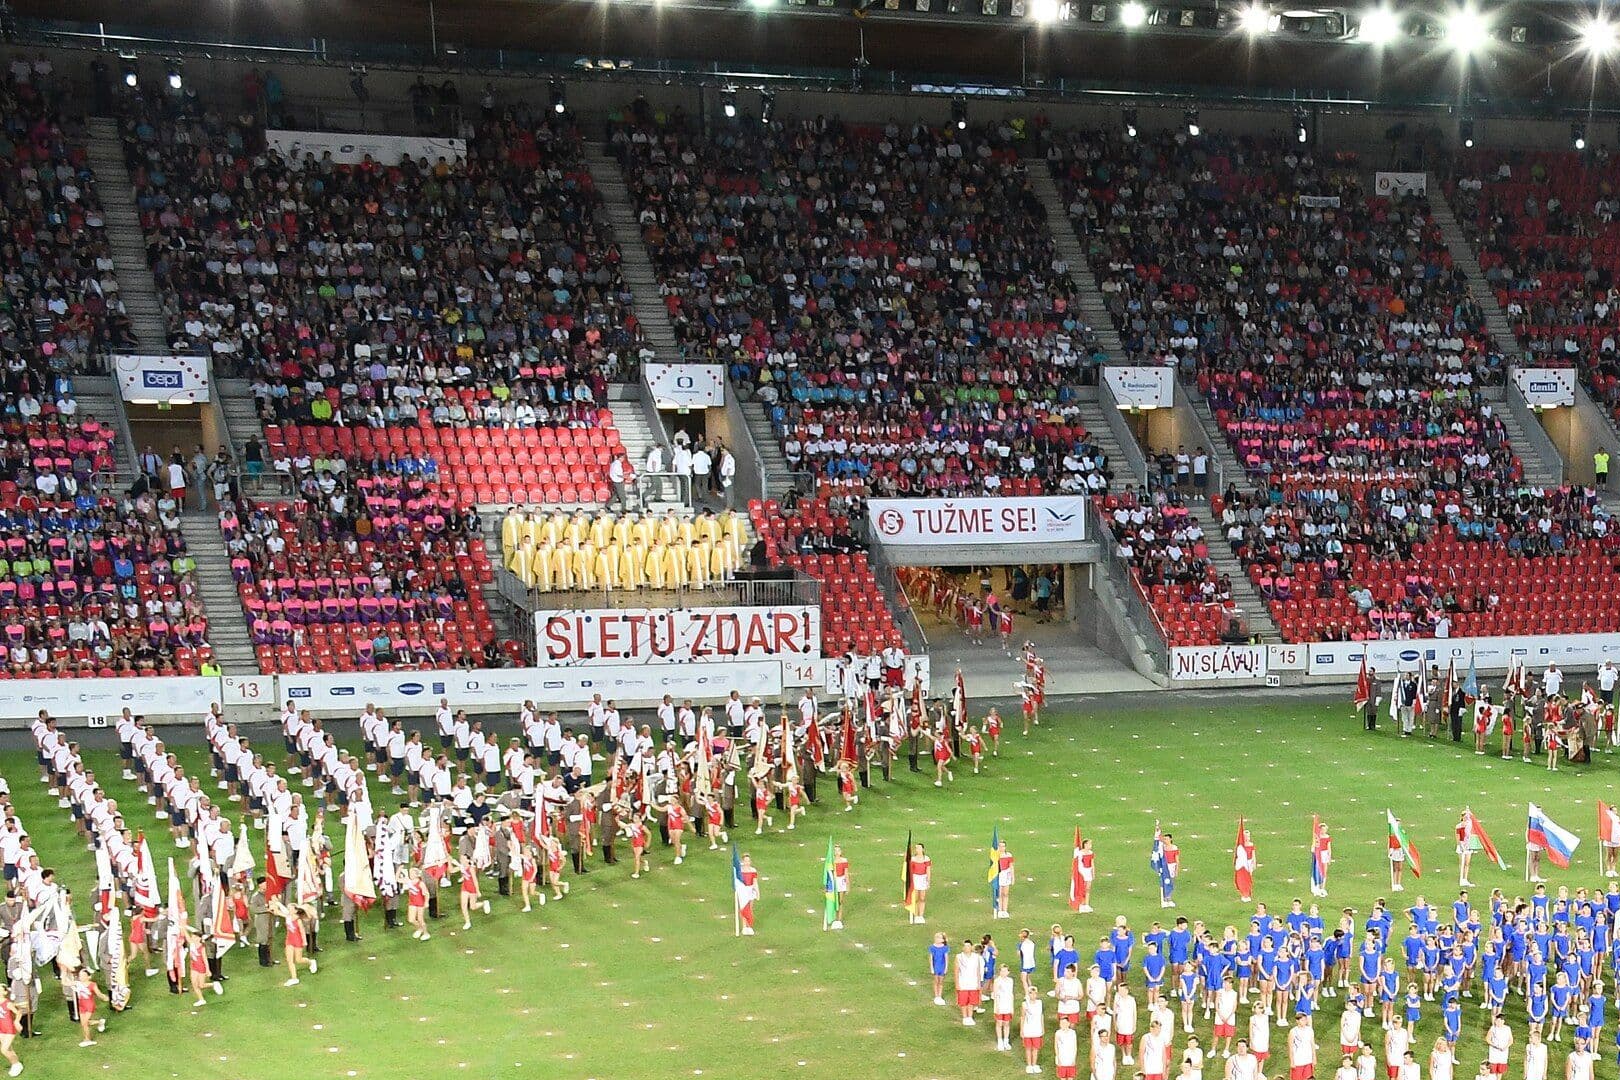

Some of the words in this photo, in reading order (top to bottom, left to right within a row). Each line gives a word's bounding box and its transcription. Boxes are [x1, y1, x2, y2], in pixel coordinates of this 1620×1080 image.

[913, 503, 993, 533] TUŽME
[1001, 507, 1037, 532] SE!
[546, 614, 674, 660] SLETU
[690, 612, 811, 658] ZDAR!
[1179, 655, 1195, 673] NI
[1279, 650, 1296, 664] 15
[795, 665, 813, 681] 14
[1267, 676, 1279, 685] 36
[238, 682, 259, 698] 13
[91, 716, 105, 725] 18
